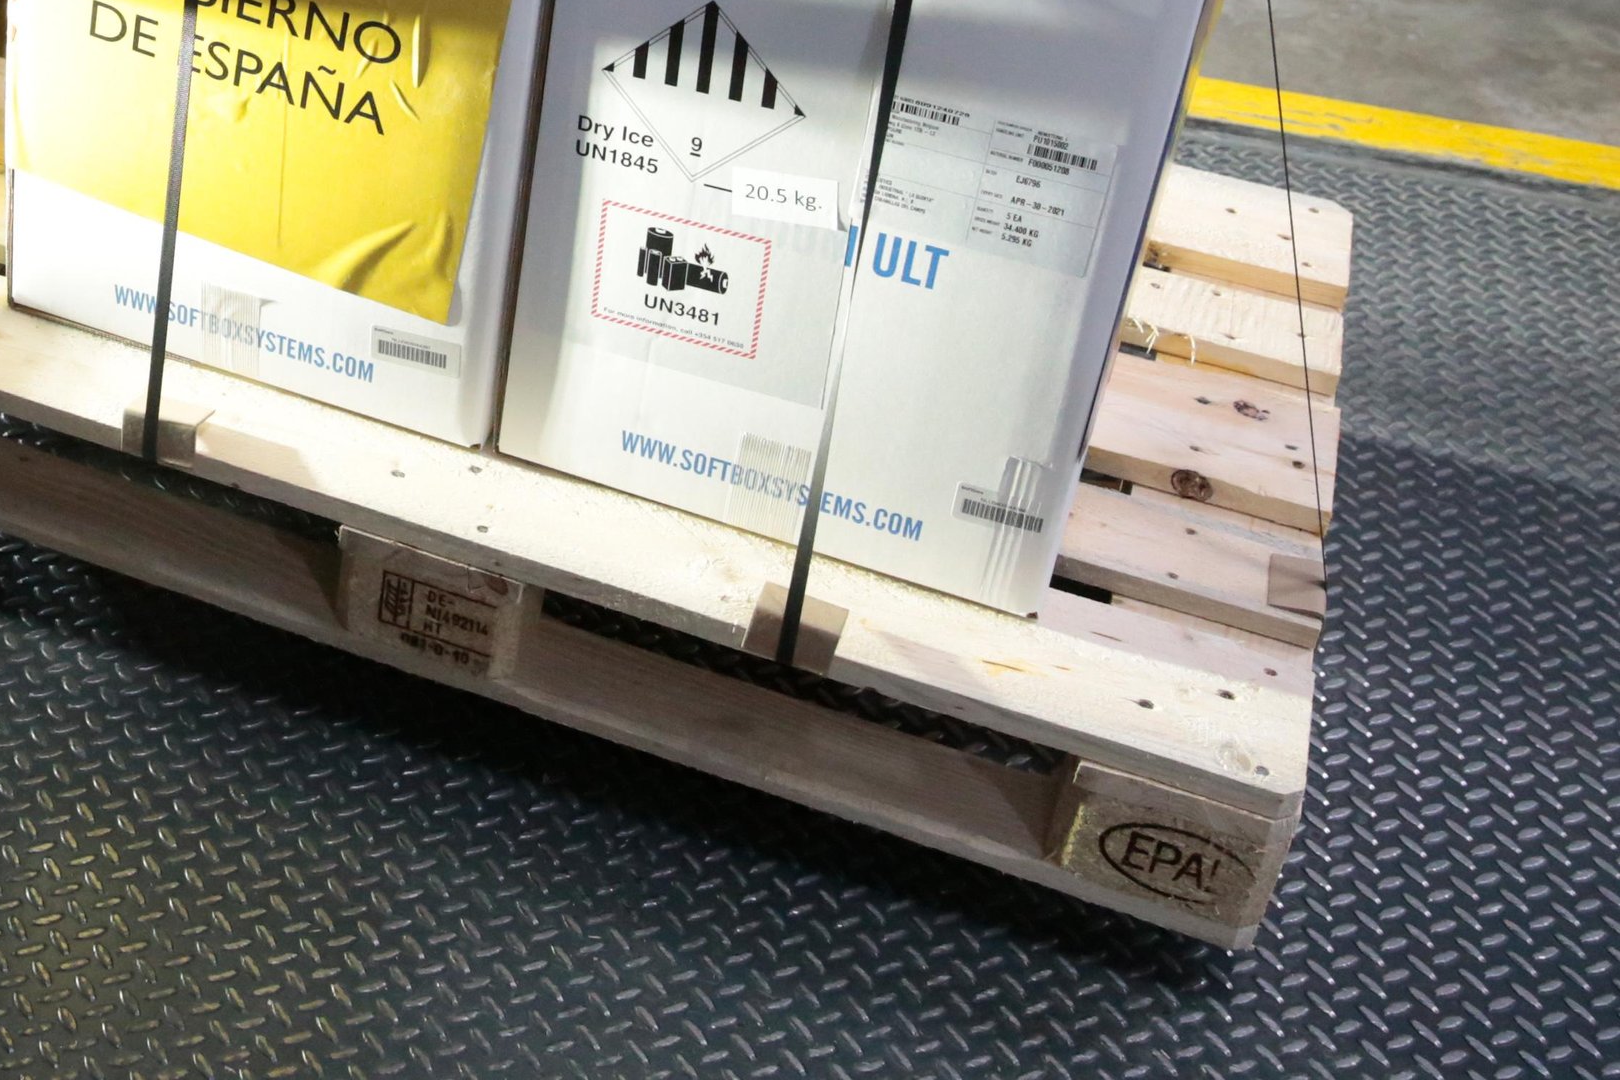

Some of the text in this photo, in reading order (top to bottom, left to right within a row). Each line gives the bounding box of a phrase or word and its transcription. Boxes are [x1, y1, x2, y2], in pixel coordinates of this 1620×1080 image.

[89, 0, 159, 57] DE
[577, 115, 654, 147] Dry Ice
[691, 137, 703, 153] 9
[576, 139, 659, 174] UN1845
[745, 183, 822, 212] 20.5 kg.
[1012, 214, 1023, 223] EA
[1028, 229, 1040, 238] KG
[1021, 238, 1033, 247] KG
[872, 232, 949, 289] ULT
[644, 294, 719, 325] UN3481
[114, 283, 374, 383] WWWSOFTBOXSYSTEMS.COM
[622, 430, 923, 541] WWW.SOFTBOXSYSEMS.COM
